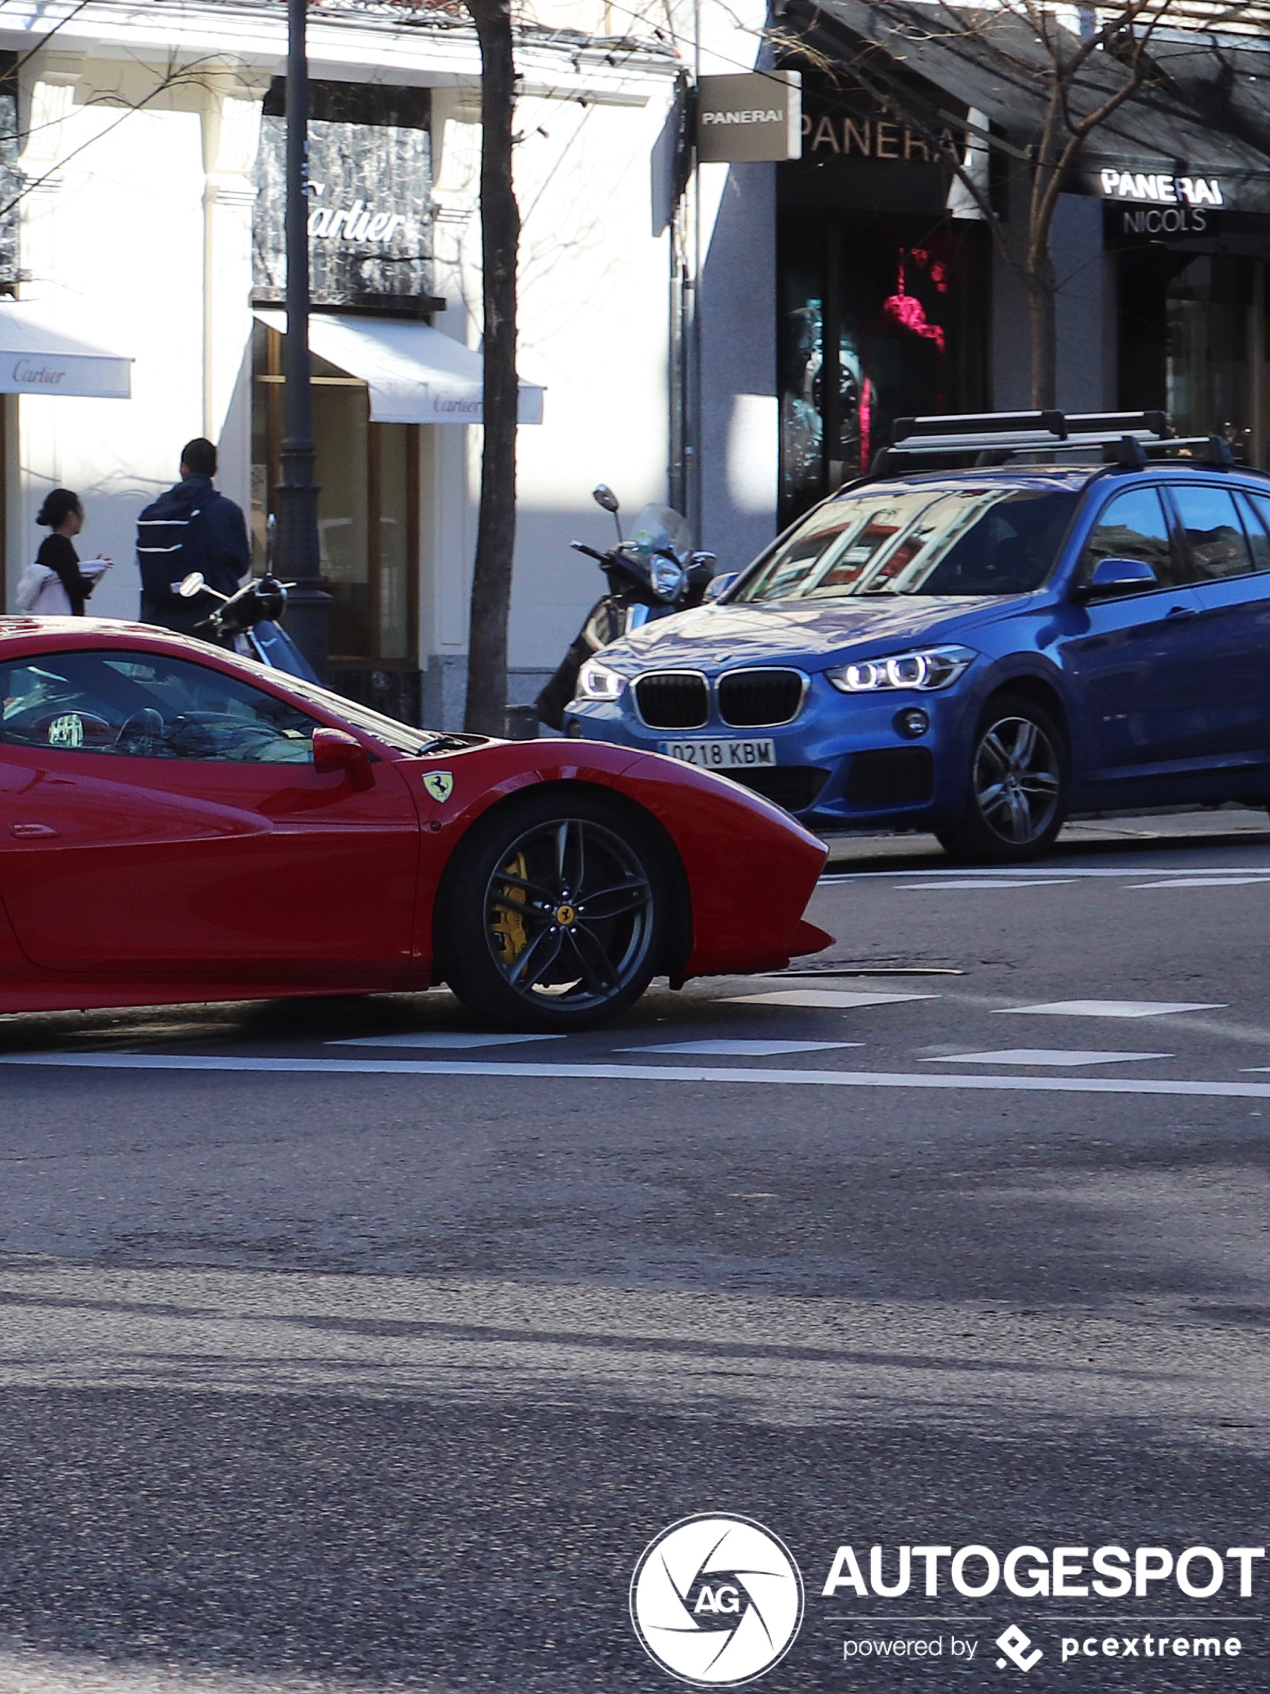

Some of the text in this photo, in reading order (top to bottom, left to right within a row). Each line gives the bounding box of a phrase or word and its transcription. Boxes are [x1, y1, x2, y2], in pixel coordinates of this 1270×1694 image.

[702, 110, 783, 126] PANERAI
[1100, 168, 1224, 205] PANERAI
[307, 181, 406, 242] artier
[1123, 208, 1207, 233] NICOLS
[12, 359, 67, 384] Cartier
[673, 742, 771, 765] 0218 KBM
